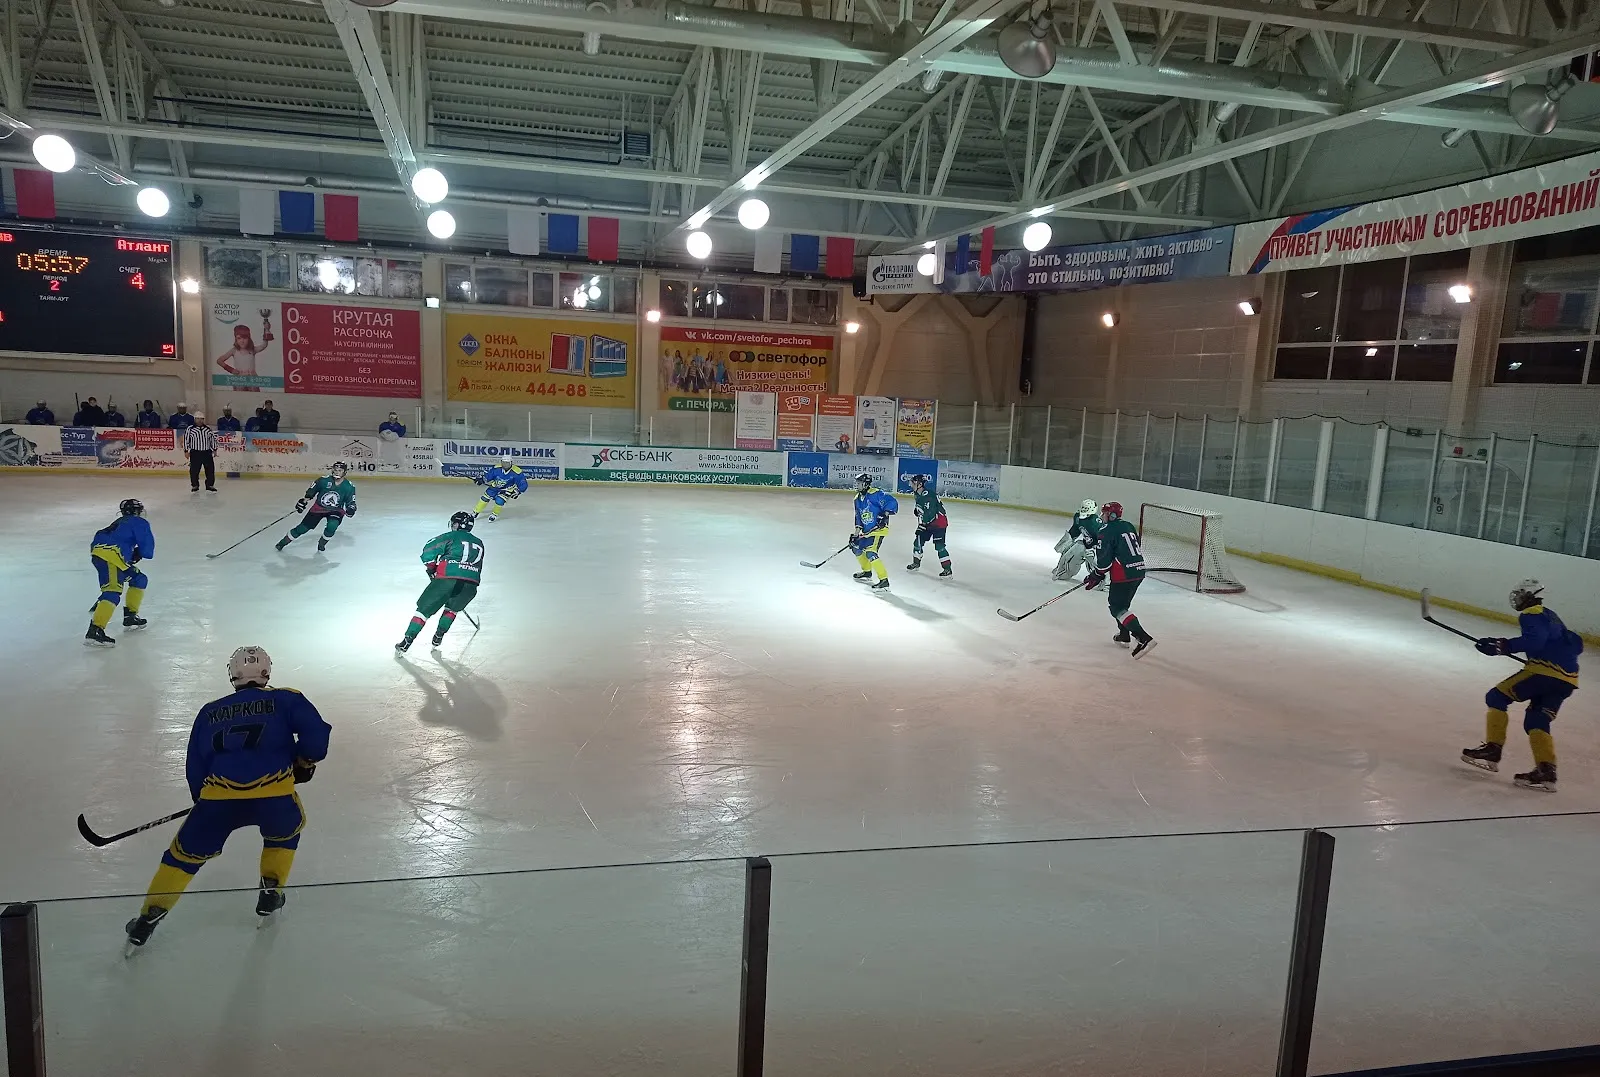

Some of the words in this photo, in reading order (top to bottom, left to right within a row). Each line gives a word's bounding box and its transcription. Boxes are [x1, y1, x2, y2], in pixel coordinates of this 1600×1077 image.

[1270, 231, 1320, 260] ПРИВЕТ
[1325, 214, 1428, 254] УЧАСТНИКАМ
[1433, 168, 1600, 238] СОРЕВНОВАНИЙ
[117, 239, 170, 253] Атлант
[1028, 252, 1061, 267] Быть
[1065, 248, 1130, 267] здоровым,
[1135, 244, 1165, 260] жить
[1168, 236, 1213, 256] активно
[38, 248, 68, 257] ВРЕМЯ
[17, 252, 89, 274] 05:57
[119, 266, 141, 274] СЧЕТ
[1027, 271, 1048, 285] это
[1051, 268, 1105, 285] стильно,
[1109, 258, 1176, 281] позитивно!
[42, 274, 67, 282] ПЕРИОД
[131, 272, 145, 290] 4
[50, 280, 60, 291] 2
[214, 303, 240, 311] ДОКТОР
[286, 307, 309, 325] 0%
[333, 310, 394, 327] КРУТАЯ
[287, 328, 310, 345] 0%
[334, 328, 393, 339] РАССРОЧКА
[701, 332, 812, 346] vk.com/svetofor_pechora
[343, 341, 364, 349] УСЛУГИ
[365, 341, 394, 350] КЛИНИКИ
[485, 334, 518, 346] ОКНА
[485, 348, 545, 360] БАЛКОНЫ
[757, 352, 827, 367] светофор
[484, 361, 542, 373] ЖАЛЮЗИ
[289, 369, 302, 384] 6
[312, 374, 343, 383] ПЕРВОГО
[345, 376, 371, 384] ВЗНОСА
[379, 378, 417, 386] ПЕРЕПЛАТЫ
[737, 370, 776, 381] Низкие
[778, 369, 811, 382] цены!
[525, 383, 587, 397] 444-88
[720, 383, 759, 393] Мечта?
[763, 382, 827, 393] Реальность!
[686, 400, 728, 411] ПЕЧОРА,
[609, 450, 673, 462] СКБ-БАНК
[698, 453, 759, 462] 8-800-1000-600
[698, 462, 759, 470] www.skbbank.ru
[812, 466, 824, 475] 50
[610, 471, 627, 480] ВСЕ
[629, 472, 654, 481] ВИДЫ
[656, 472, 712, 482] БАНКОВСКИХ
[713, 474, 739, 483] УСЛУГ
[461, 541, 484, 565] 17
[212, 722, 267, 751] 17
